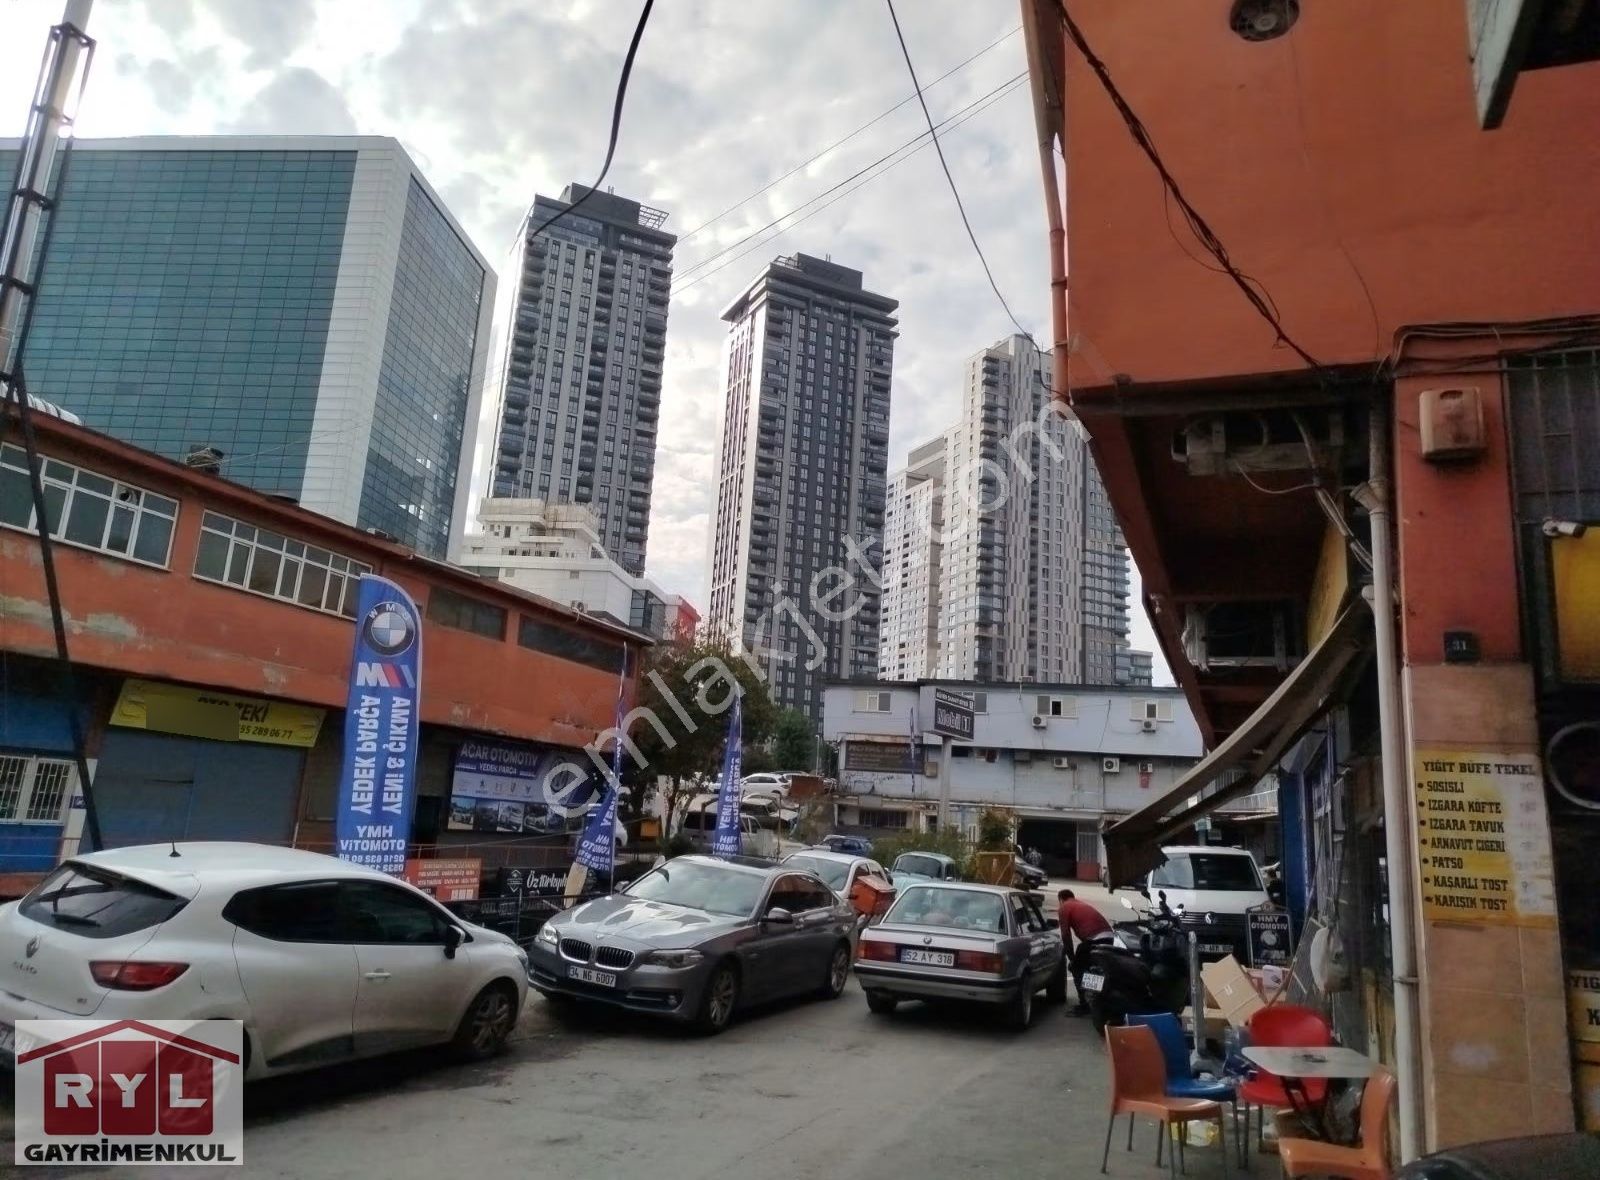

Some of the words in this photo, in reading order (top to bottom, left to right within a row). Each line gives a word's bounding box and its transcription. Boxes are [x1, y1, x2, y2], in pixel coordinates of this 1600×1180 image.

[937, 708, 961, 730] Mobil
[460, 742, 489, 760] ACAR
[1494, 763, 1536, 776] TEKEL
[1468, 798, 1502, 813] KÖFTE
[1469, 820, 1505, 833] TAVUK
[1431, 838, 1474, 850] ARNAVUT
[1432, 856, 1463, 869] PATSO
[526, 870, 539, 889] Öz
[1481, 878, 1508, 891] TOST
[1480, 899, 1508, 911] TOST
[906, 951, 918, 960] 52
[920, 953, 934, 962] AY
[937, 954, 953, 964] 318
[569, 967, 579, 978] 34
